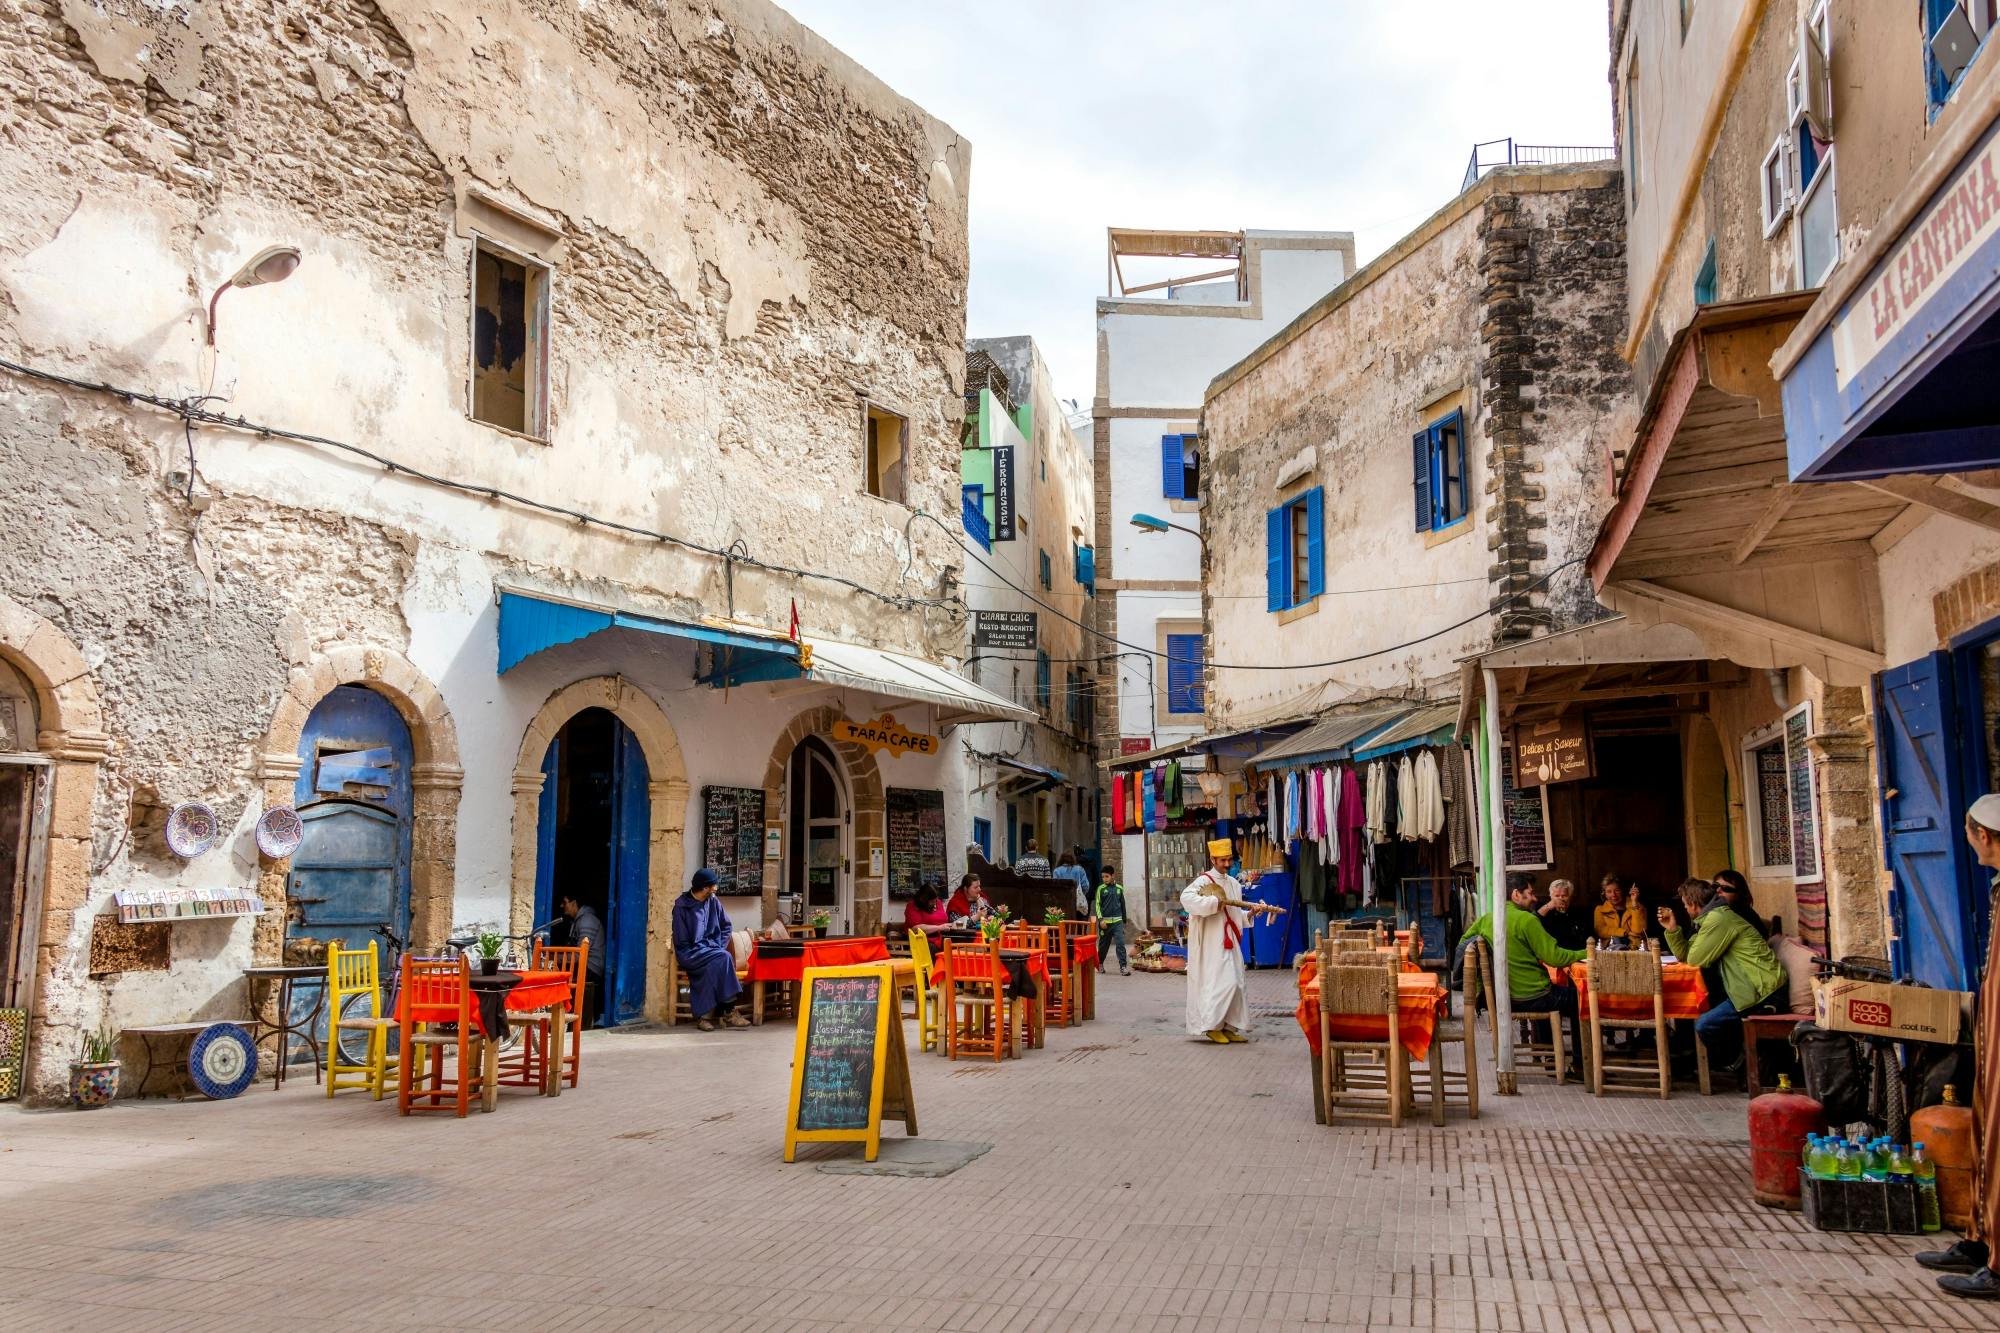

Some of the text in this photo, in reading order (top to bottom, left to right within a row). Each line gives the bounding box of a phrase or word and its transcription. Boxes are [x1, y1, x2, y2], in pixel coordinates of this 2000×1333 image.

[1871, 151, 2000, 340] LA CANTINA
[998, 448, 1008, 526] TERRASSE
[1010, 612, 1030, 622] CHIC
[847, 725, 888, 744] TARA
[1554, 738, 1583, 751] Saveur
[226, 900, 234, 914] 8
[238, 900, 246, 913] 9
[1853, 1002, 1888, 1016] KOOL
[1852, 1011, 1889, 1024] FOOD
[1920, 1024, 1937, 1034] life
